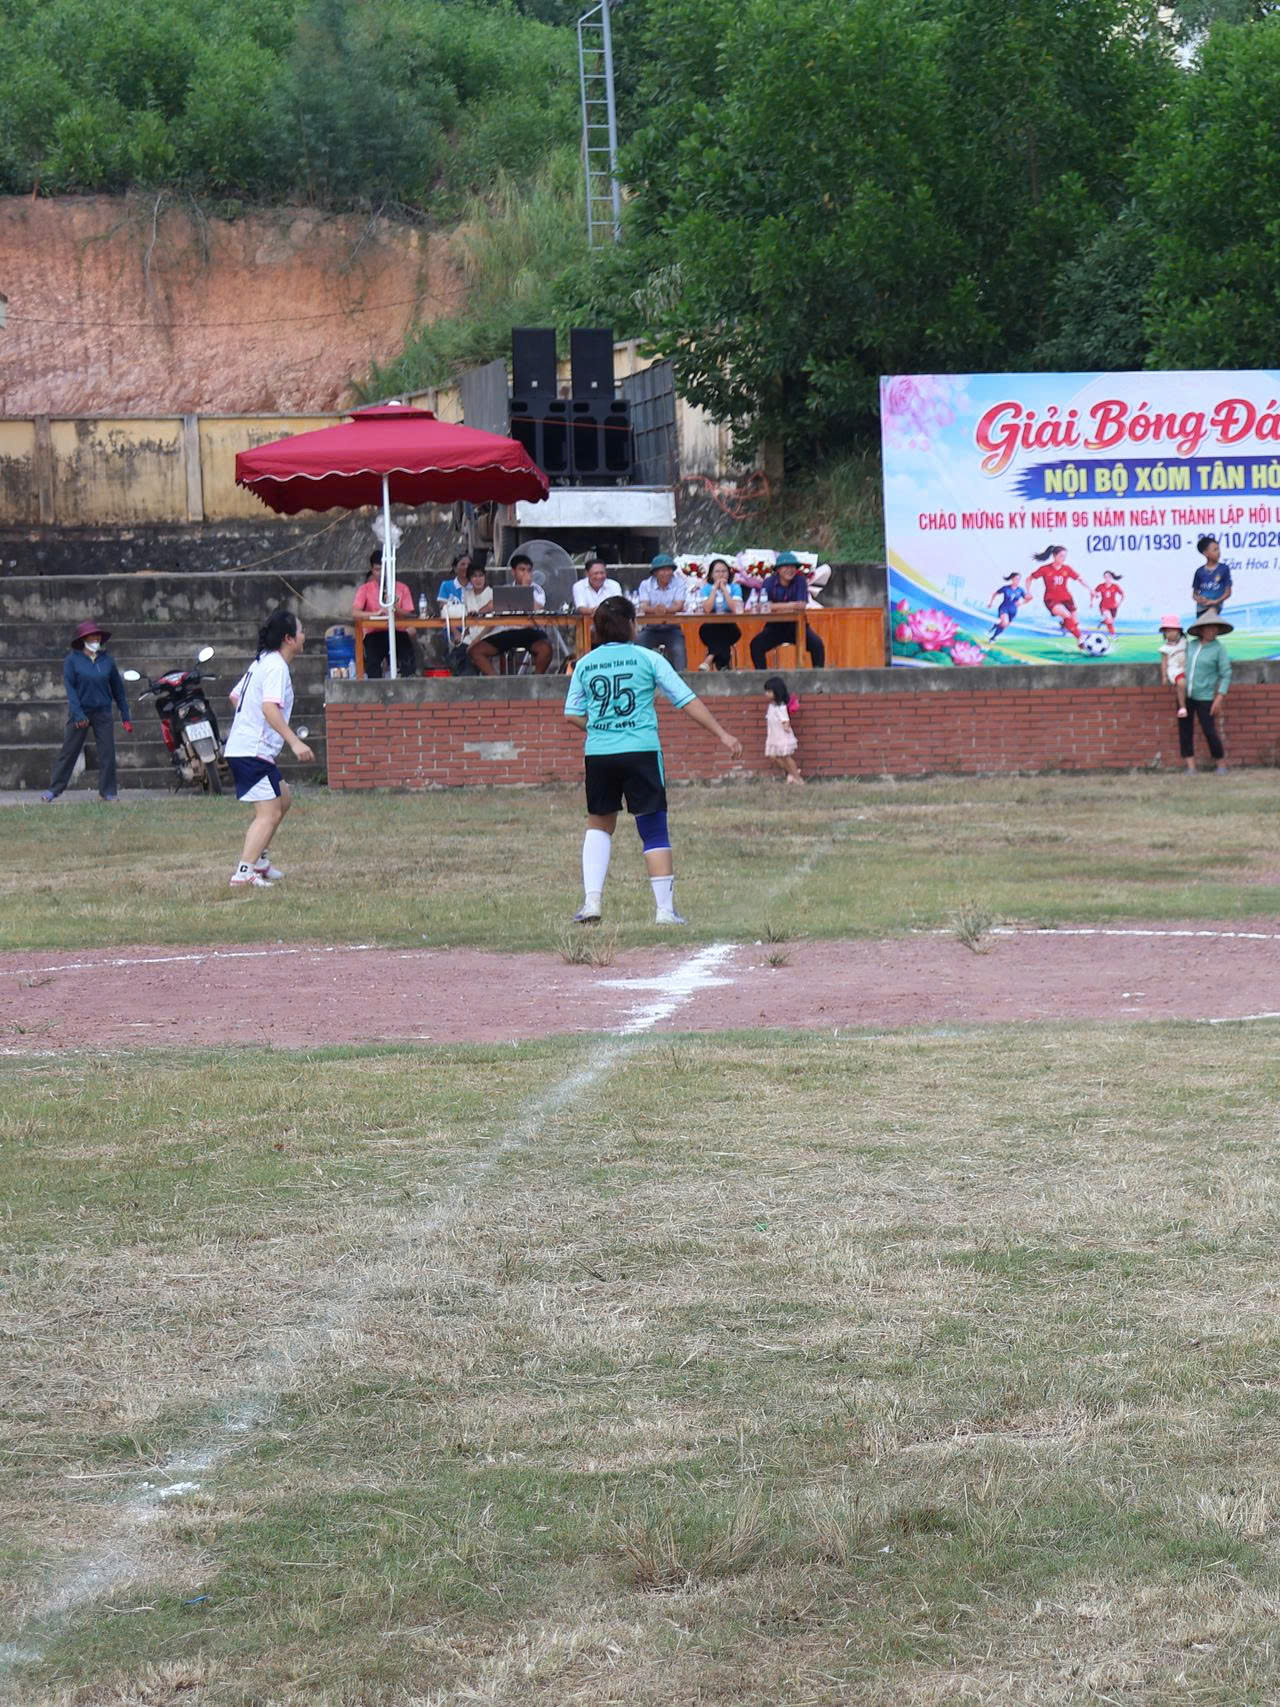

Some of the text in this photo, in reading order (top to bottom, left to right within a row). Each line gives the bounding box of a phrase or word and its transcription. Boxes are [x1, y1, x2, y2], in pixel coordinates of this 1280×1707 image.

[976, 402, 1080, 476] Giải
[1084, 399, 1208, 457] Bóng
[1044, 463, 1087, 498] NỘI
[1094, 462, 1128, 497] BỘ
[1134, 462, 1192, 493] XÓM
[1196, 460, 1246, 490] TÂN
[919, 509, 957, 530] CHÀO
[961, 508, 1004, 530] MỪNG
[1009, 505, 1027, 529] KỶ
[1031, 507, 1068, 532] NIỆM
[1072, 511, 1089, 528] 96
[1093, 507, 1125, 527] NĂM
[1130, 506, 1167, 526] NGÀY
[1171, 505, 1215, 526] THÀNH
[1219, 504, 1244, 528] LẬP
[1249, 503, 1271, 527] HỘI
[1087, 534, 1182, 553] (20/10/1930
[589, 673, 636, 717] 95
